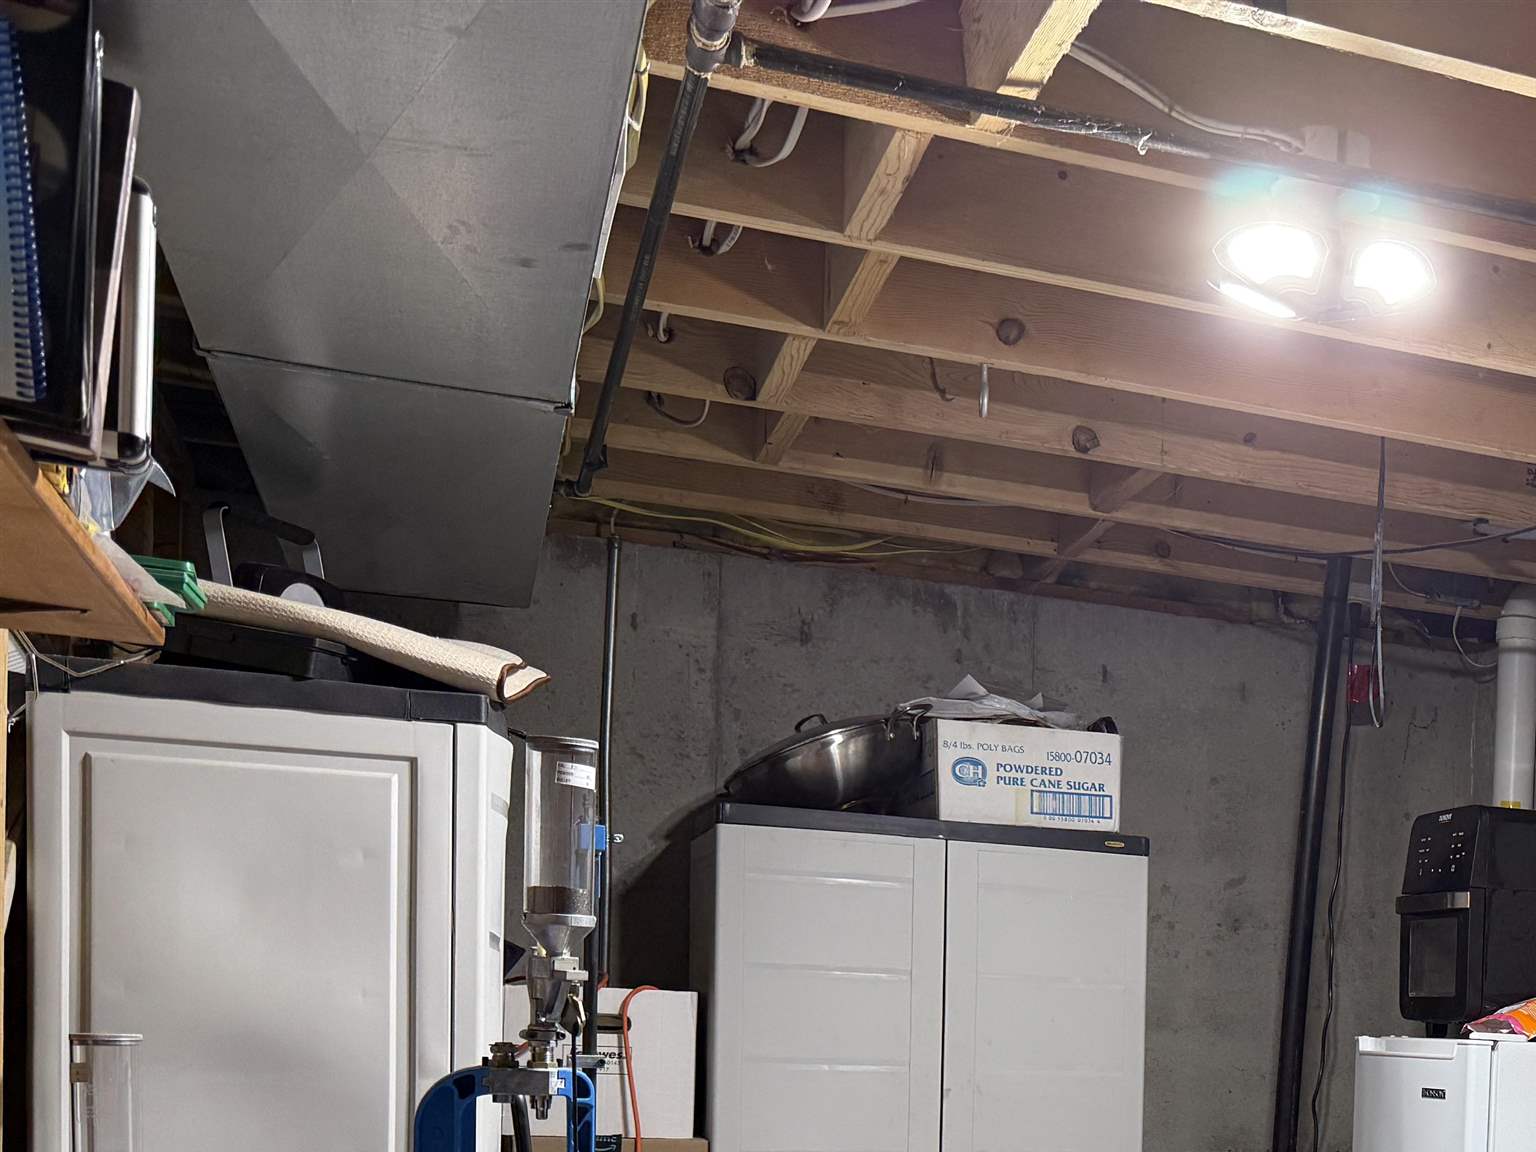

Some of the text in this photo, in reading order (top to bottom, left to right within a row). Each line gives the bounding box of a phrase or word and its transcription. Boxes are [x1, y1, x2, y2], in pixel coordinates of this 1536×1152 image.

[959, 741, 975, 751] lbs.
[976, 743, 999, 753] POLY
[1001, 745, 1024, 754] BAGS
[1046, 750, 1112, 766] 15800-07034
[996, 763, 1063, 777] POWDERED
[996, 776, 1105, 792] PURE CANE SUGAR
